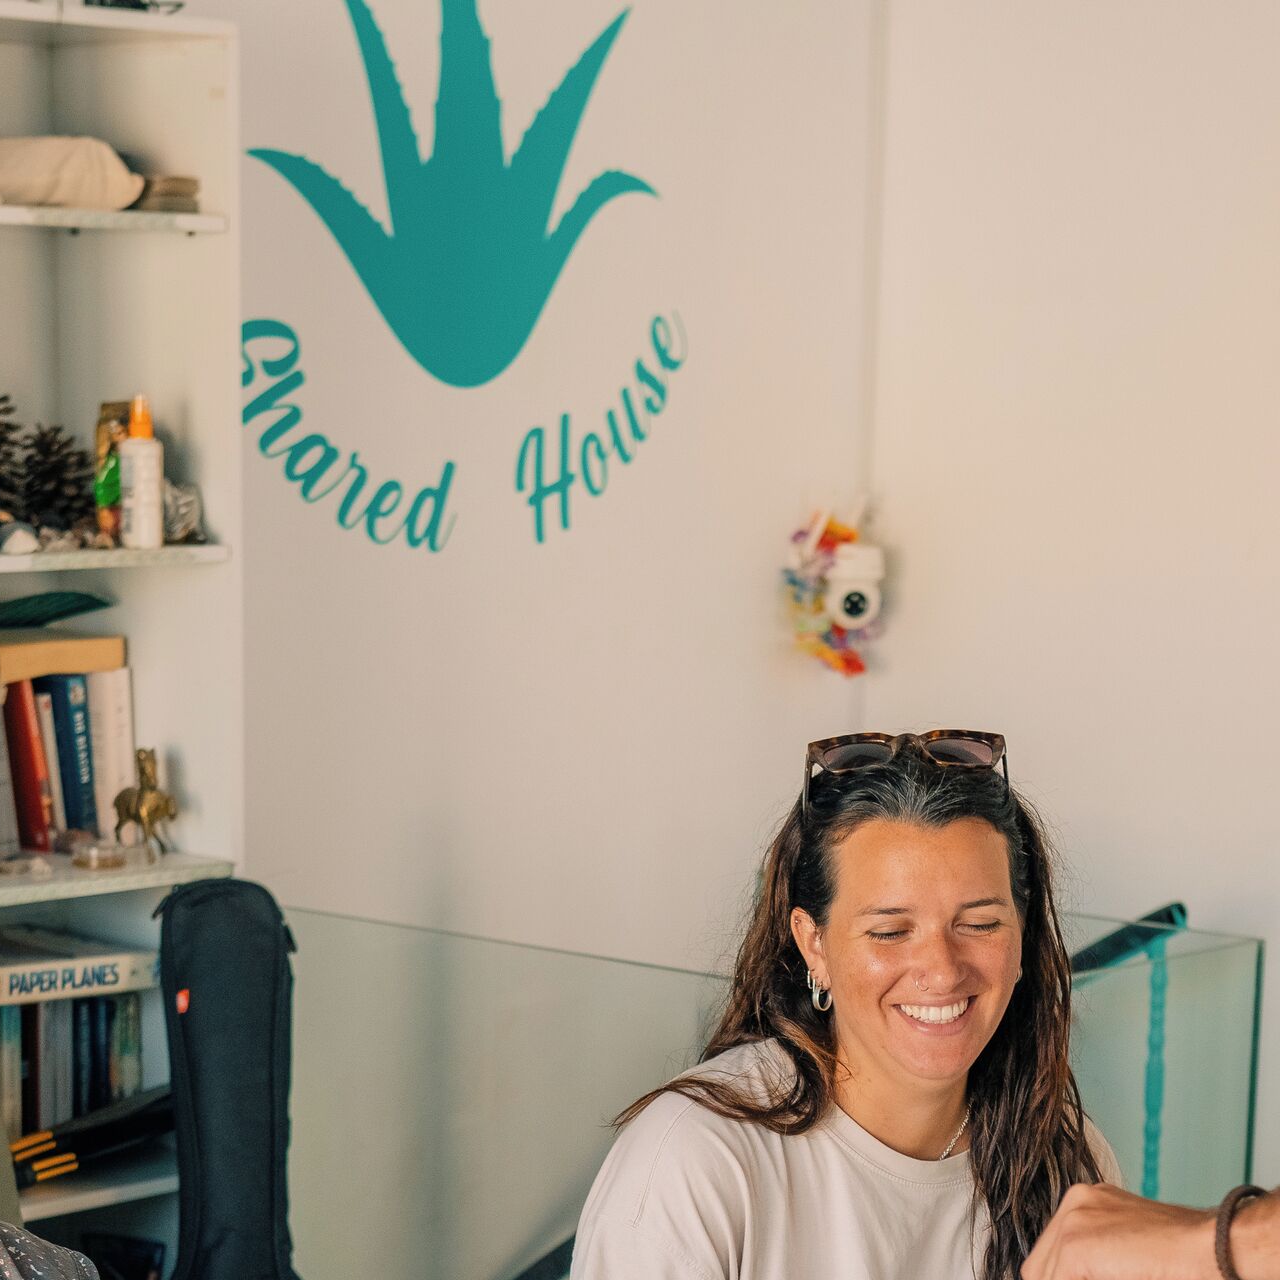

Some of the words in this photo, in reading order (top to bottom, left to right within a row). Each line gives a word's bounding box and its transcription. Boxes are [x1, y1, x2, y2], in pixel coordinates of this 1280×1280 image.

[241, 318, 458, 553] Shared
[515, 310, 690, 544] House
[9, 969, 58, 996] PAPER
[61, 963, 120, 990] PLANES
